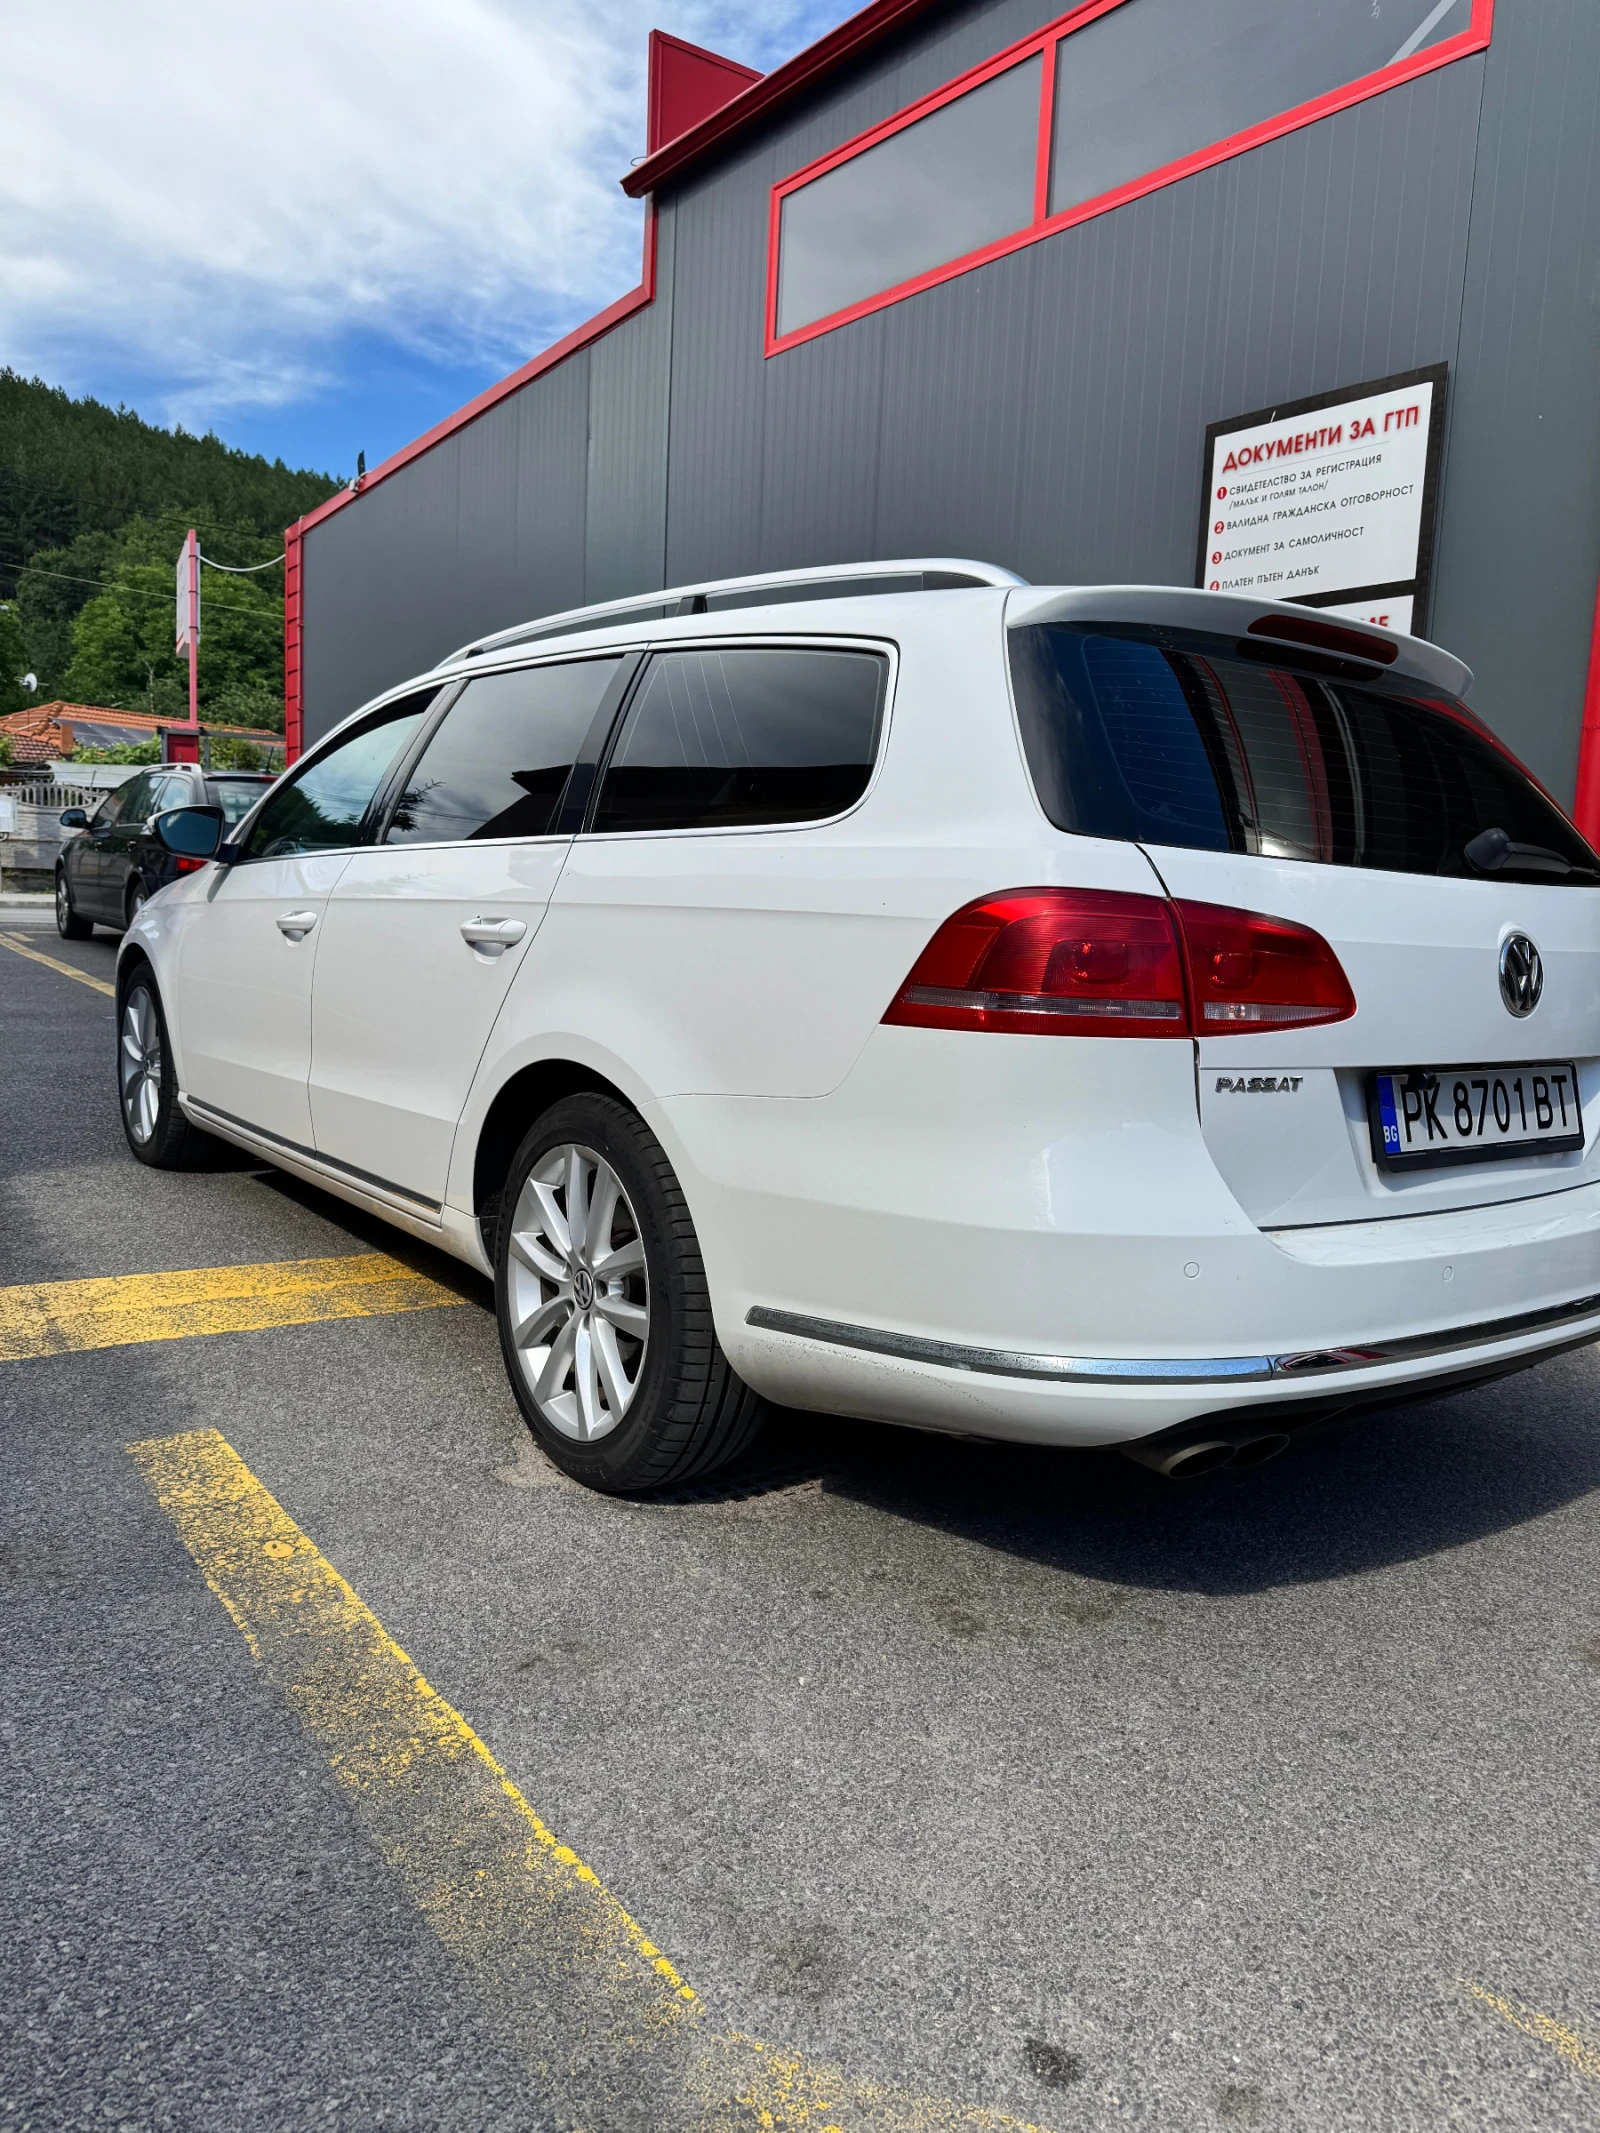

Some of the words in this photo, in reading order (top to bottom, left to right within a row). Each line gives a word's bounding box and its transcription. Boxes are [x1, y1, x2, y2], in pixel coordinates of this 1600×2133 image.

[1222, 424, 1342, 473] ДОКУМЕНТИ
[1349, 417, 1375, 440] ЗА
[1383, 405, 1419, 432] ГТП
[1229, 473, 1297, 496] СВИДЕТЕЛСТВО
[1300, 470, 1312, 480] ЗА
[1316, 454, 1382, 477] РЕГИСТРАЦИЯ
[1226, 514, 1269, 530] ВАЛИДНА
[1272, 500, 1336, 521] ГРАЖДАНСКА
[1340, 484, 1414, 507] ОТГОВОРНОСТ
[1261, 494, 1268, 502] И
[1269, 489, 1296, 501] ГОЛЯМ
[1224, 543, 1271, 561] ДОКУМЕНТ
[1273, 541, 1285, 551] ЗА
[1288, 526, 1364, 548] САМОЛИЧНОСТ
[1222, 576, 1254, 590] ПЛАТЕН
[1256, 571, 1283, 584] ПЪТЕН
[1286, 565, 1320, 580] ДАНЪК
[1215, 1075, 1303, 1093] PASSAT
[1383, 1125, 1398, 1143] BG
